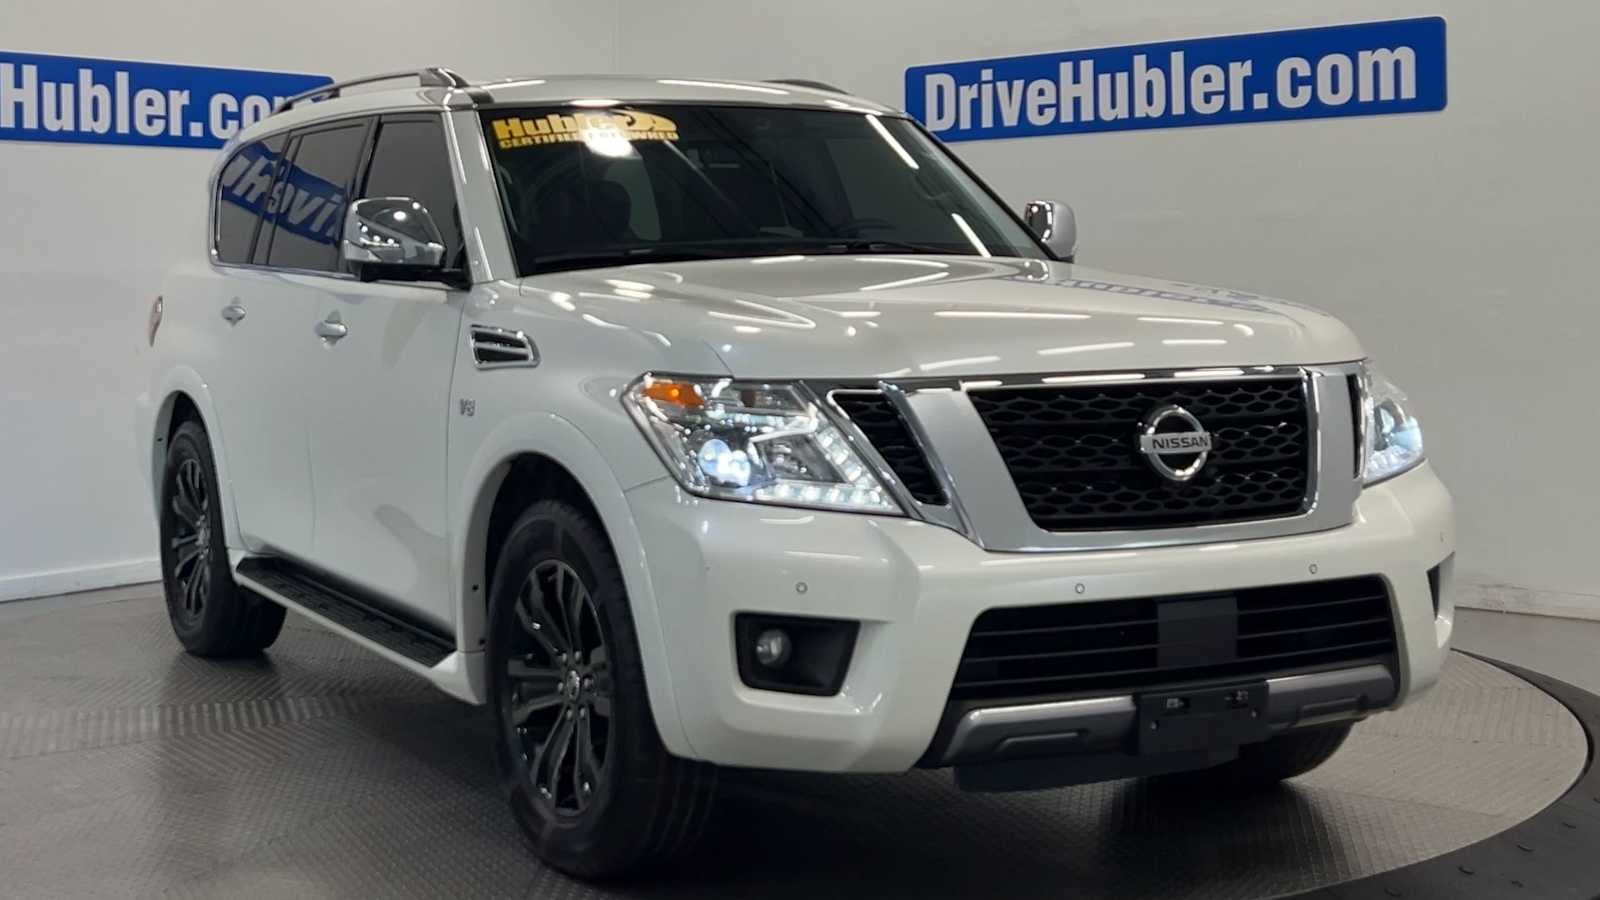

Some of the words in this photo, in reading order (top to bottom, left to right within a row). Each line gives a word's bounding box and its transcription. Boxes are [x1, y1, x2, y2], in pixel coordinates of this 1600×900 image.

[0, 61, 296, 141] Hubler.co
[924, 45, 1417, 132] DriveHubler.com
[1151, 436, 1209, 449] NISSAN
